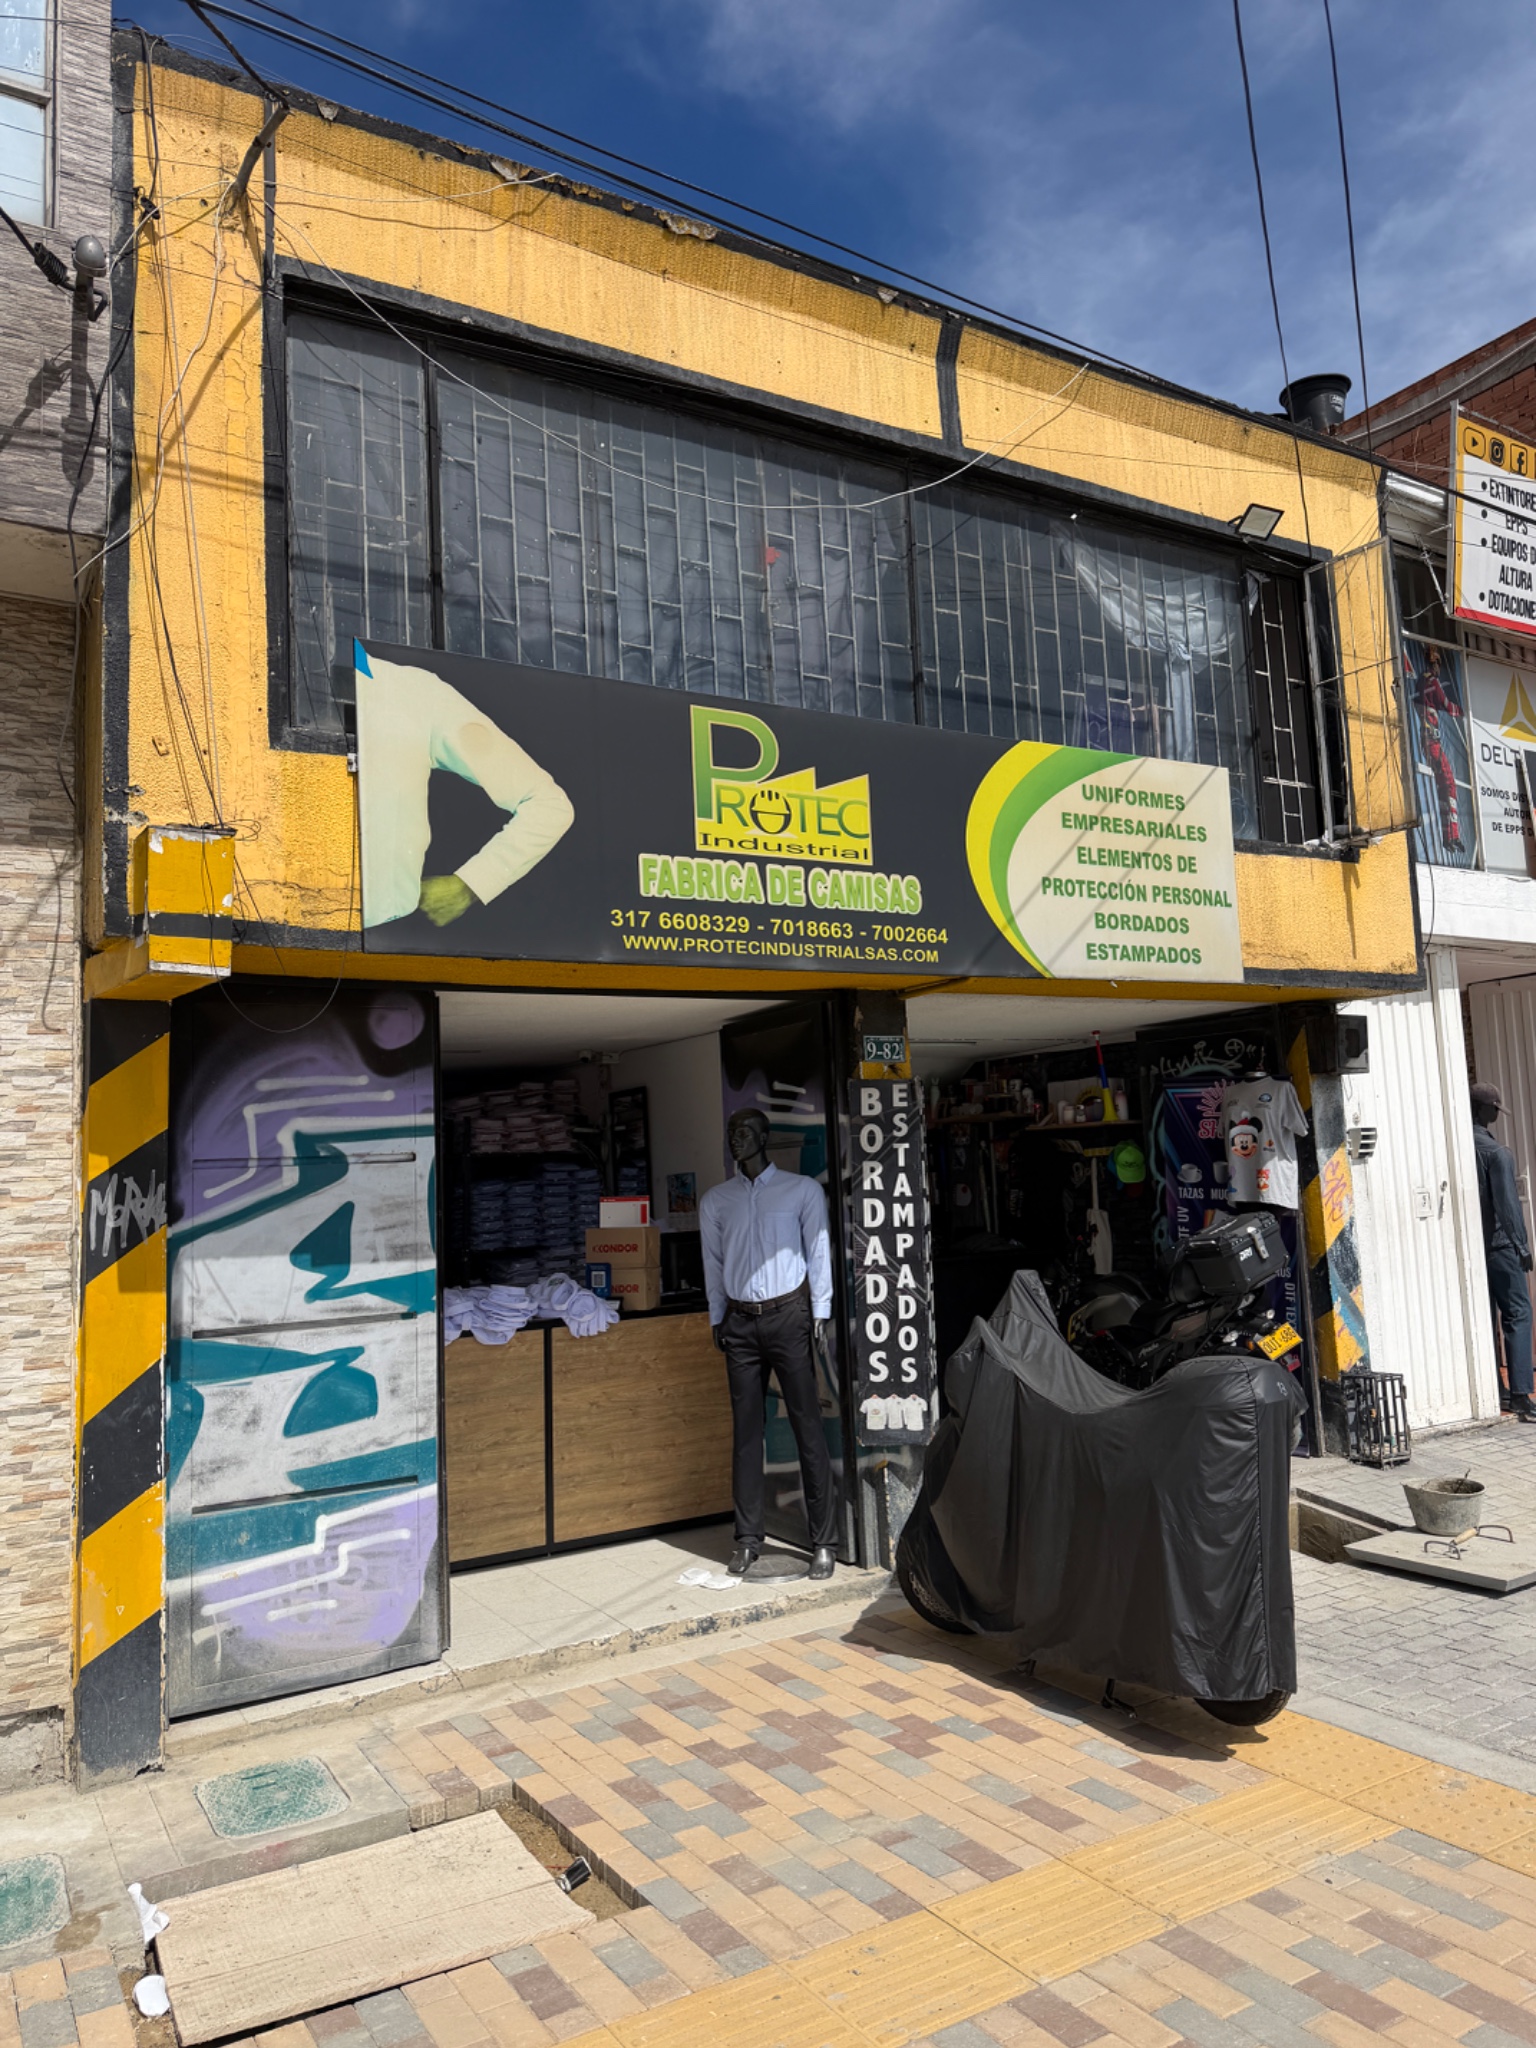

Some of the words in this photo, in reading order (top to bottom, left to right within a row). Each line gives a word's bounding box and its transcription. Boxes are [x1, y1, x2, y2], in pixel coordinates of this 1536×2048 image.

[1505, 514, 1529, 536] EPPS
[1491, 533, 1528, 562] EQUIPOS
[1499, 564, 1533, 592] ALTURA
[1081, 783, 1186, 812] UNIFORMES
[1480, 786, 1511, 800] SOMOS
[1061, 811, 1207, 843] EMPRESARIALES
[1492, 822, 1504, 833] DE
[699, 832, 868, 861] Industrial
[1077, 846, 1173, 872] ELEMENTOS
[1177, 855, 1198, 874] DE
[638, 853, 765, 905] FABRICA
[766, 863, 806, 907] DE
[809, 867, 922, 915] CAMISAS
[1041, 876, 1147, 903] PROTECCIÓN
[1152, 885, 1232, 908] PERSONAL
[610, 909, 651, 929] 317
[659, 912, 750, 934] 6608329
[770, 919, 853, 939] 7018663
[871, 925, 949, 944] 7002664
[1094, 912, 1190, 934] BORDADOS
[623, 935, 939, 963] WWW.PROTECINDUSTRIALSAS.COM
[1086, 942, 1202, 965] ESTAMPADOS
[867, 1042, 900, 1060] 9-82
[1178, 1187, 1204, 1199] TAZAS
[1177, 1206, 1190, 1222] UV
[860, 1087, 890, 1383] BORDADOS
[892, 1083, 918, 1383] ESTAMPADOS
[1177, 1224, 1190, 1238] TF
[611, 1284, 639, 1293] NDOR
[1285, 1283, 1296, 1302] DTF
